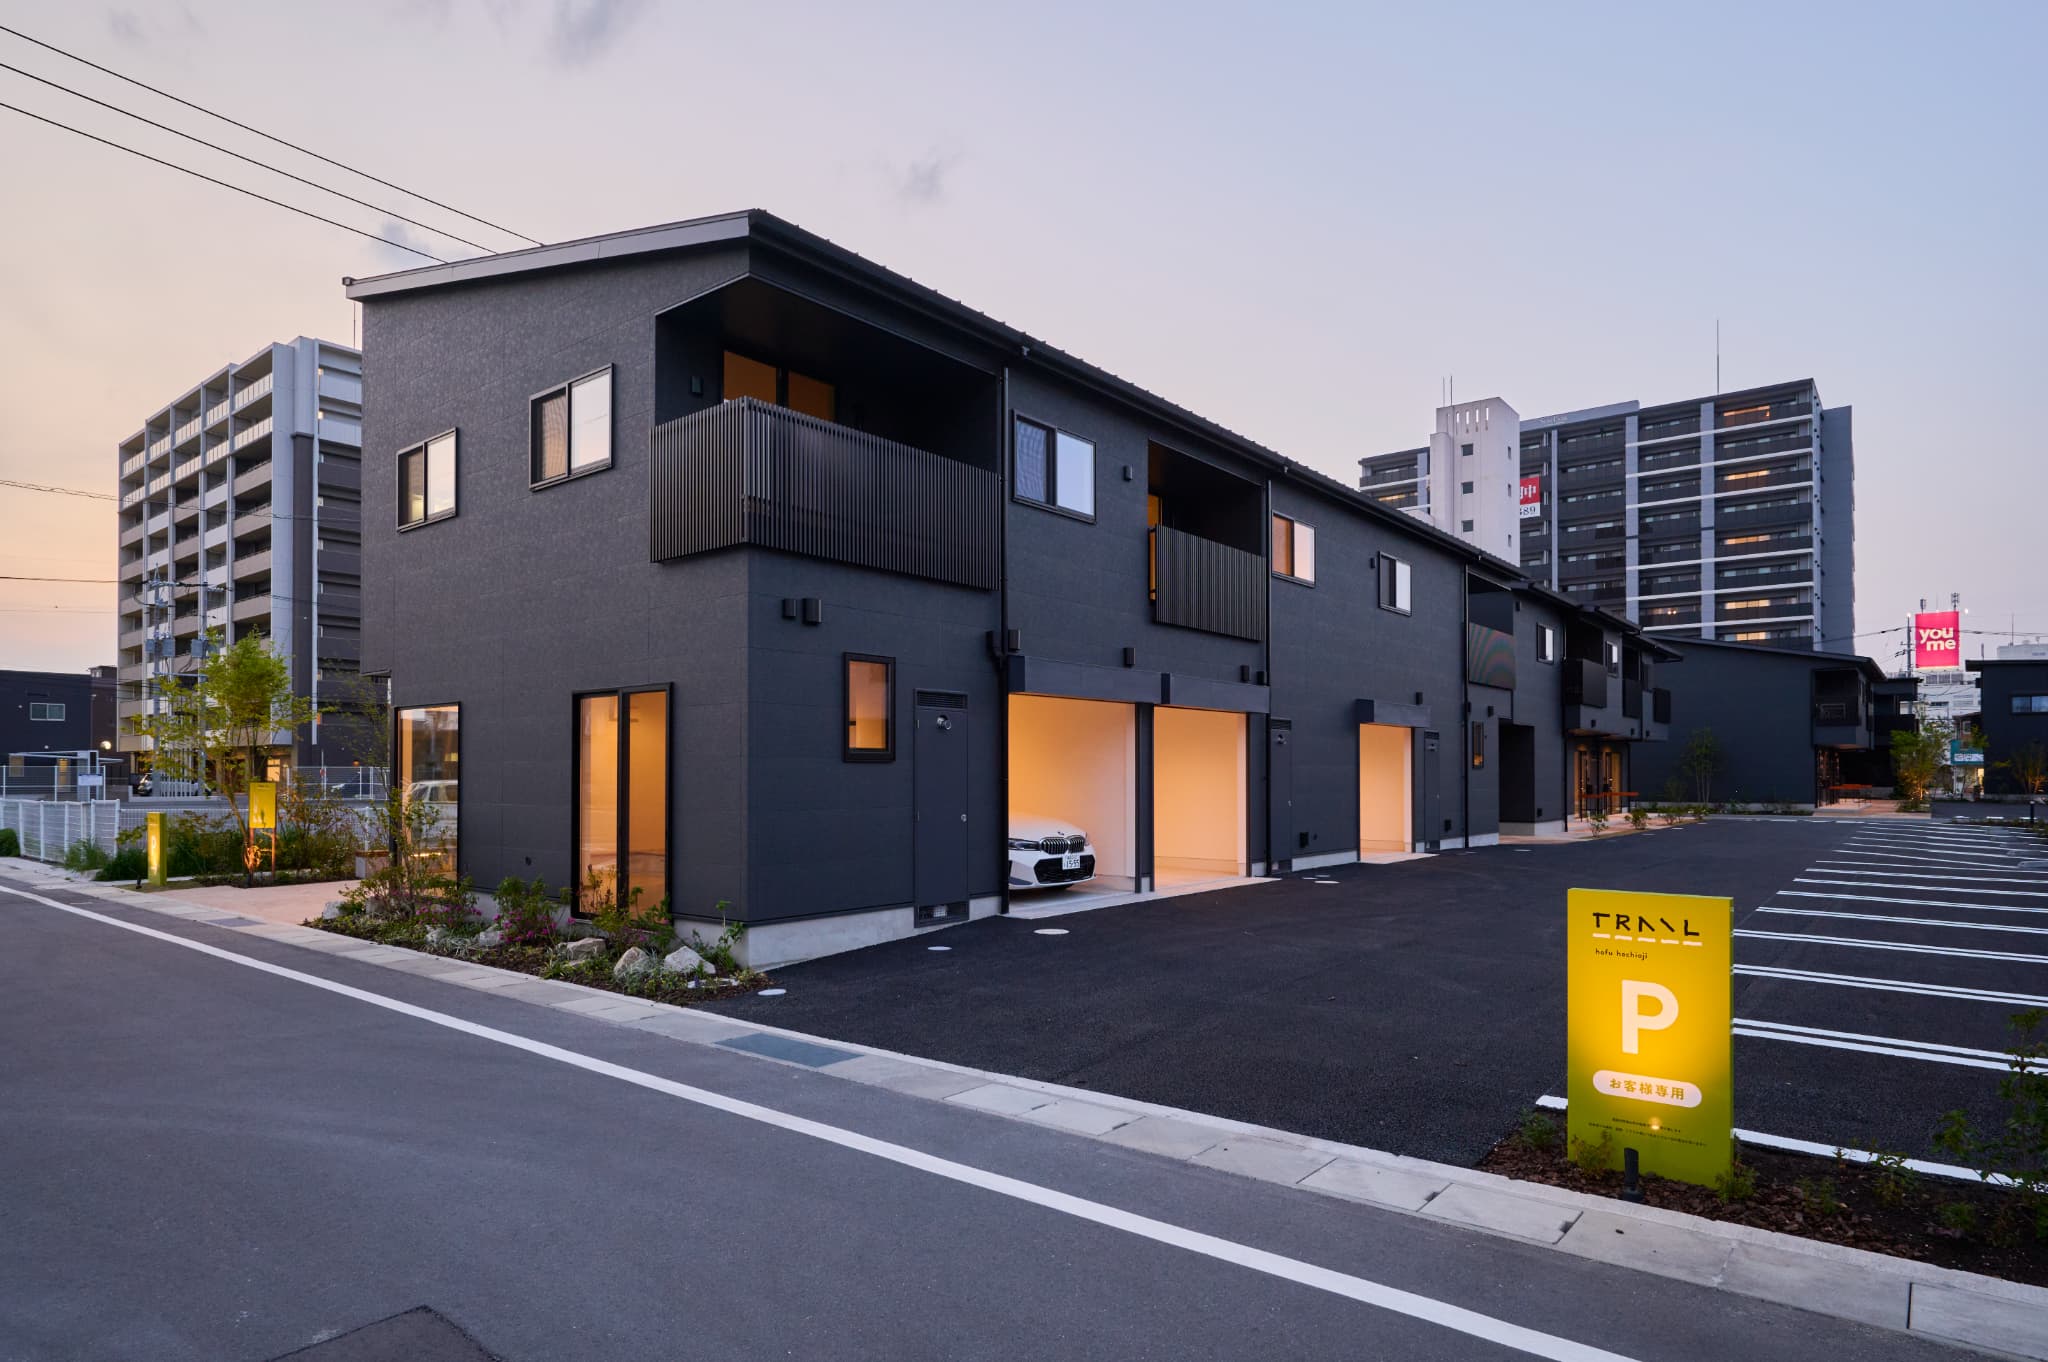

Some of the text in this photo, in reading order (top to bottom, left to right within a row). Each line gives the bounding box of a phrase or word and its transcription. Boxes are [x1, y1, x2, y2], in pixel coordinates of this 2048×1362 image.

[1919, 627, 1954, 644] you
[1926, 639, 1956, 651] me
[1621, 979, 1679, 1055] P
[1609, 1078, 1685, 1101] お客様専用
